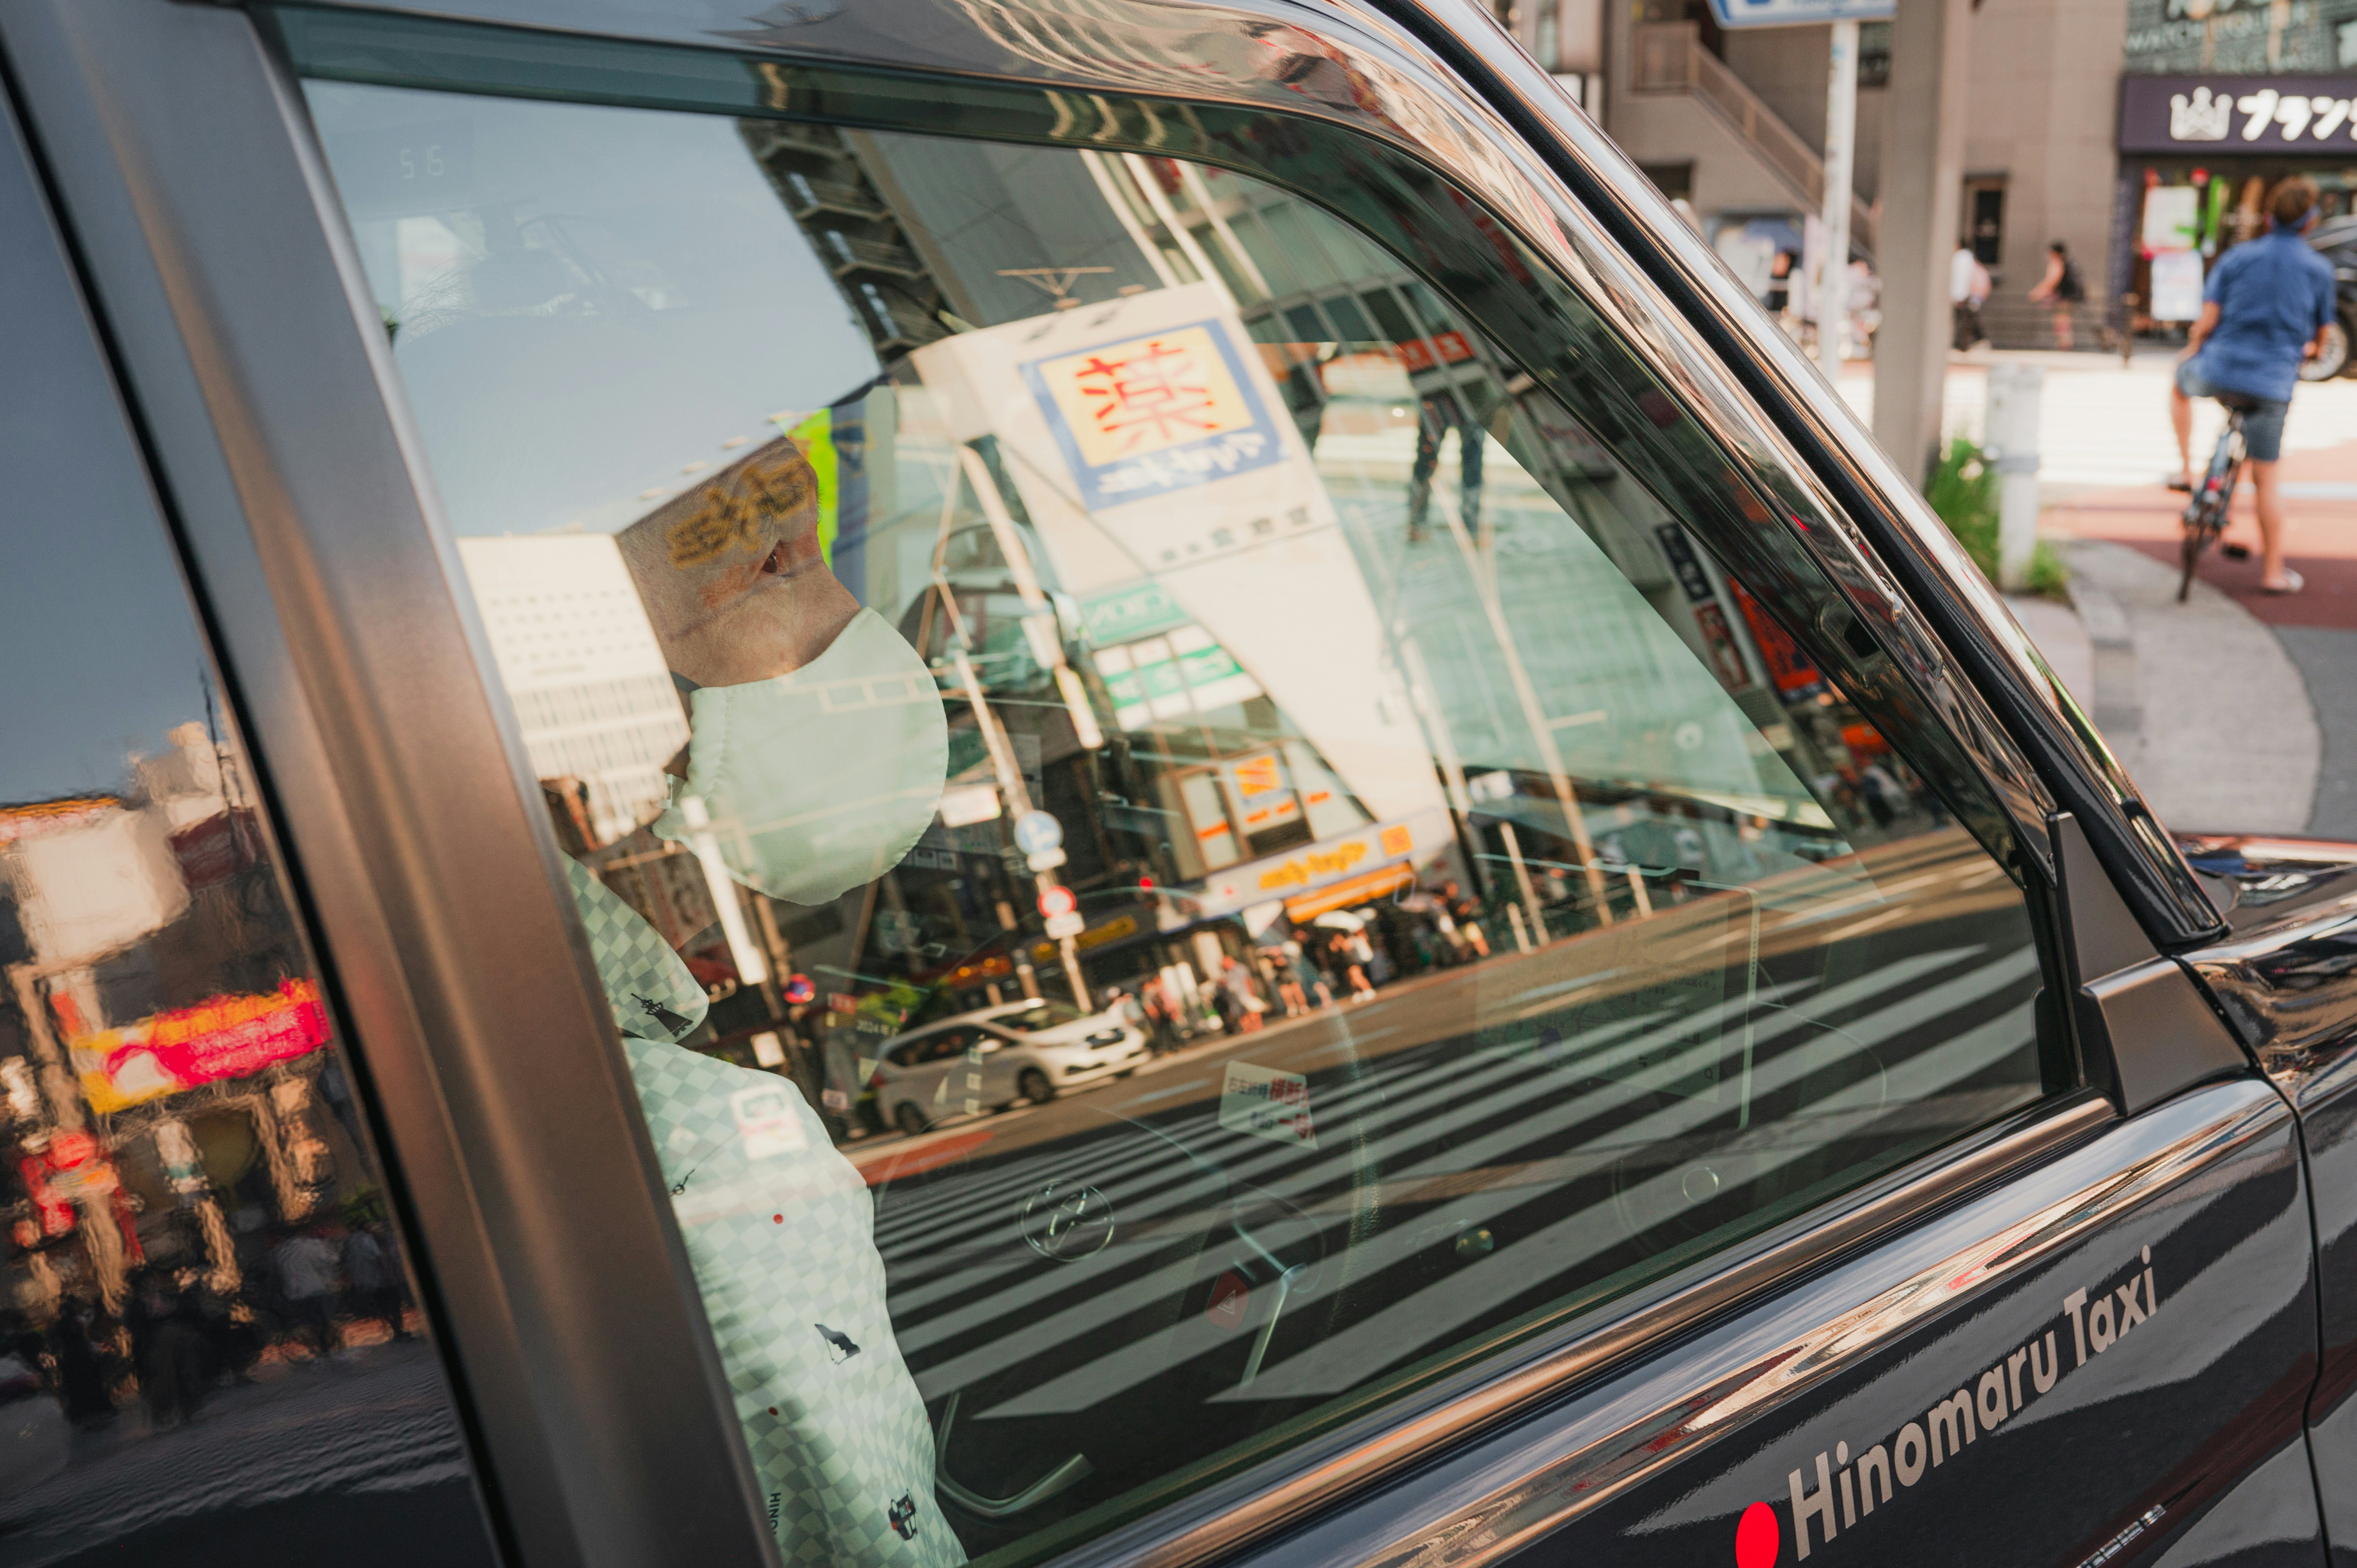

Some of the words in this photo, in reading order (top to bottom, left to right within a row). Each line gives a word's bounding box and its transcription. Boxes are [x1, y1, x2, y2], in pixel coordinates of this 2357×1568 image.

[2237, 88, 2357, 142] プラン
[1788, 1330, 2058, 1562] Hinomaru
[2064, 1245, 2157, 1367] Taxi
